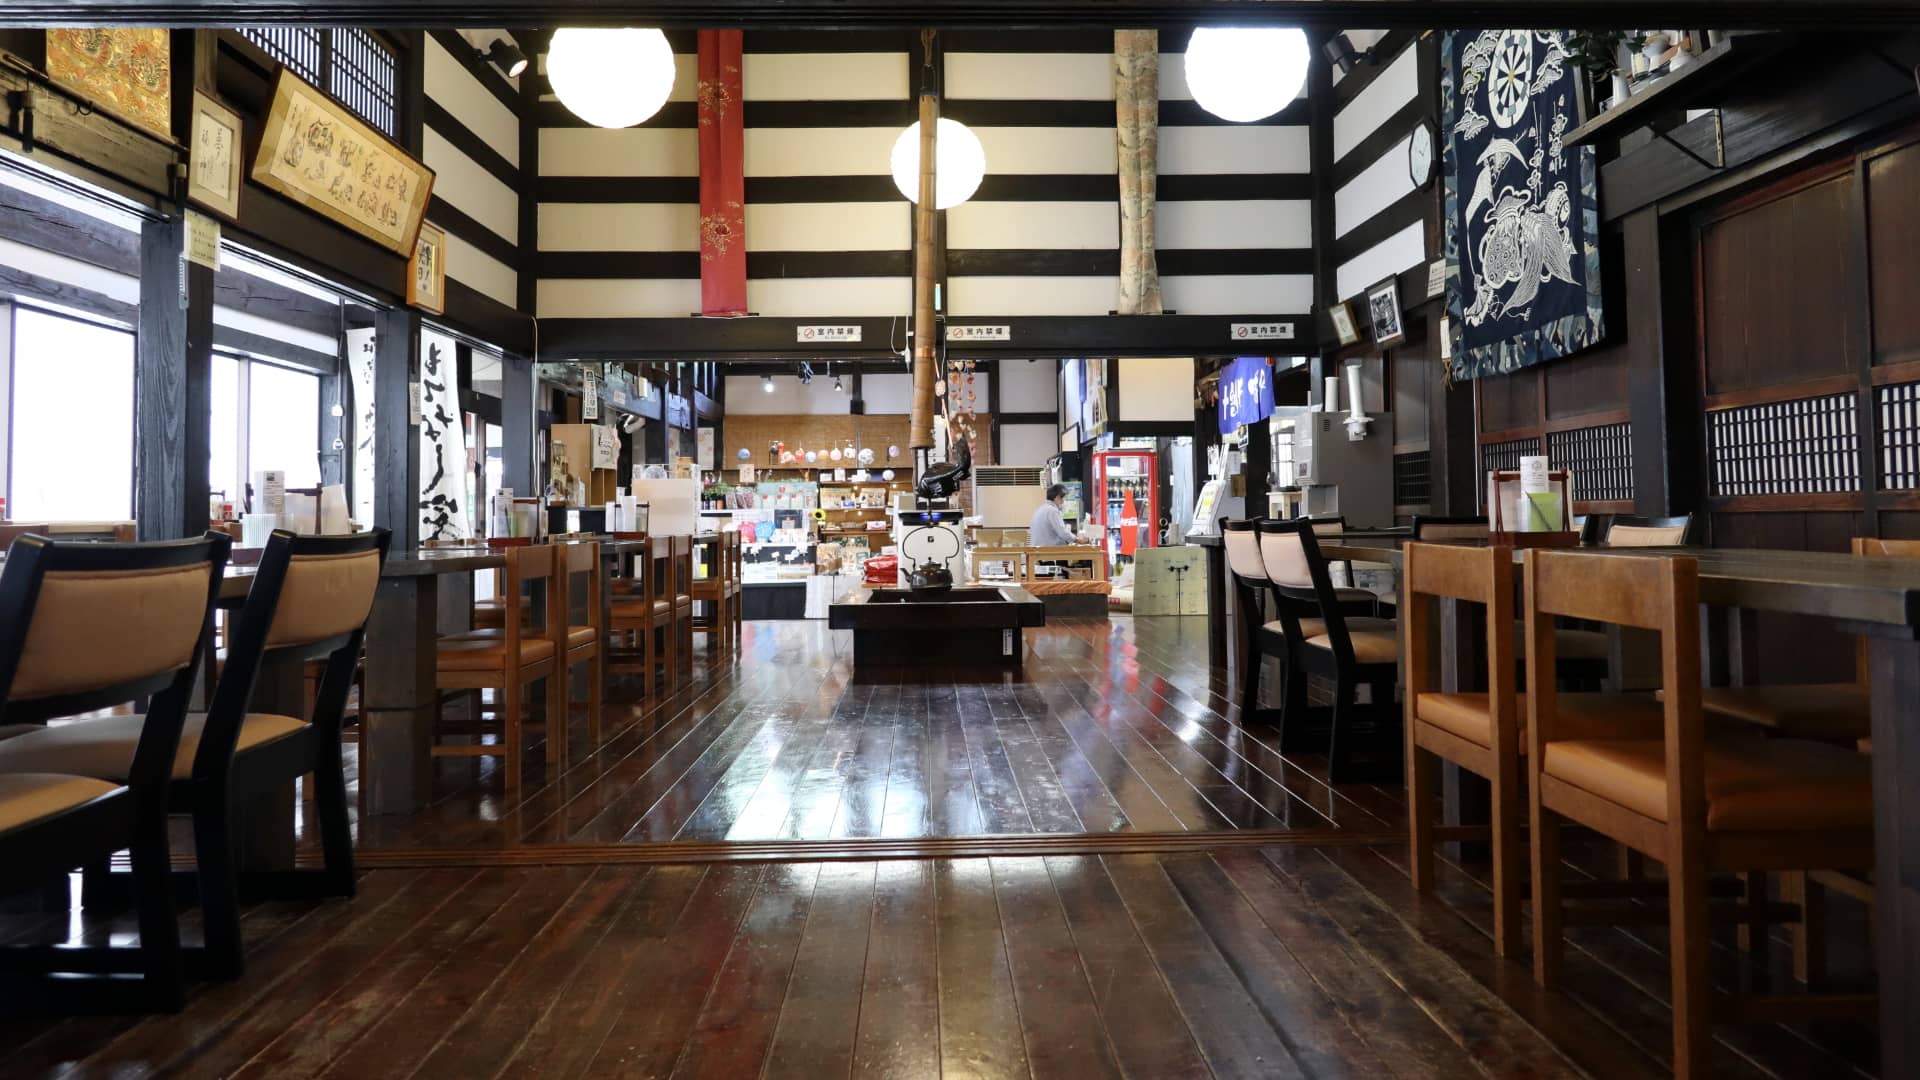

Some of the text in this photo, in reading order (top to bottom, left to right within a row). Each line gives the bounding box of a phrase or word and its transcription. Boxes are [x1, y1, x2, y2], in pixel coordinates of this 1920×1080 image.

[817, 327, 854, 336] 室内禁煙
[966, 327, 1003, 336] 室内禁煙
